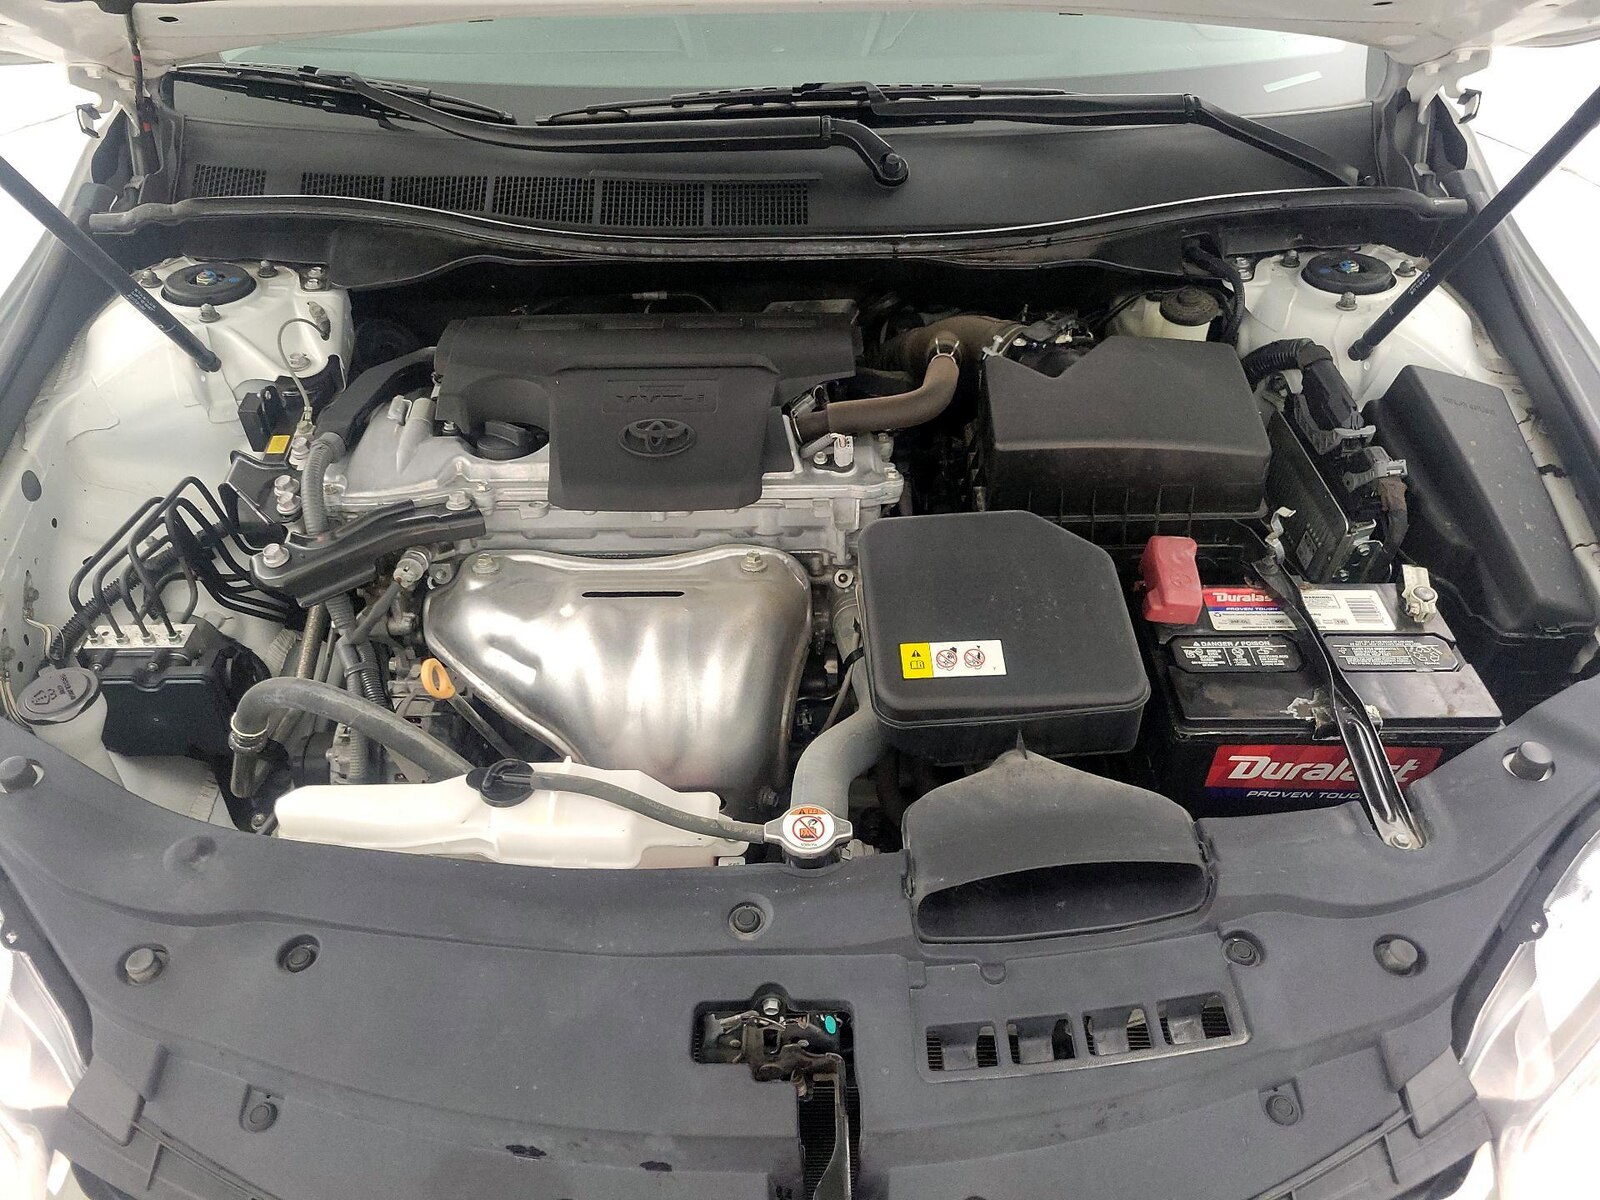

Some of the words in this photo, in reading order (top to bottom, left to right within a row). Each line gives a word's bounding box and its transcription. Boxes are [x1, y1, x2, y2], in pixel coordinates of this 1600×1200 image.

[1212, 592, 1273, 603] Duralas
[1228, 755, 1421, 783] Duralt
[1246, 790, 1313, 798] PROVEN
[1319, 791, 1363, 799] TOUG
